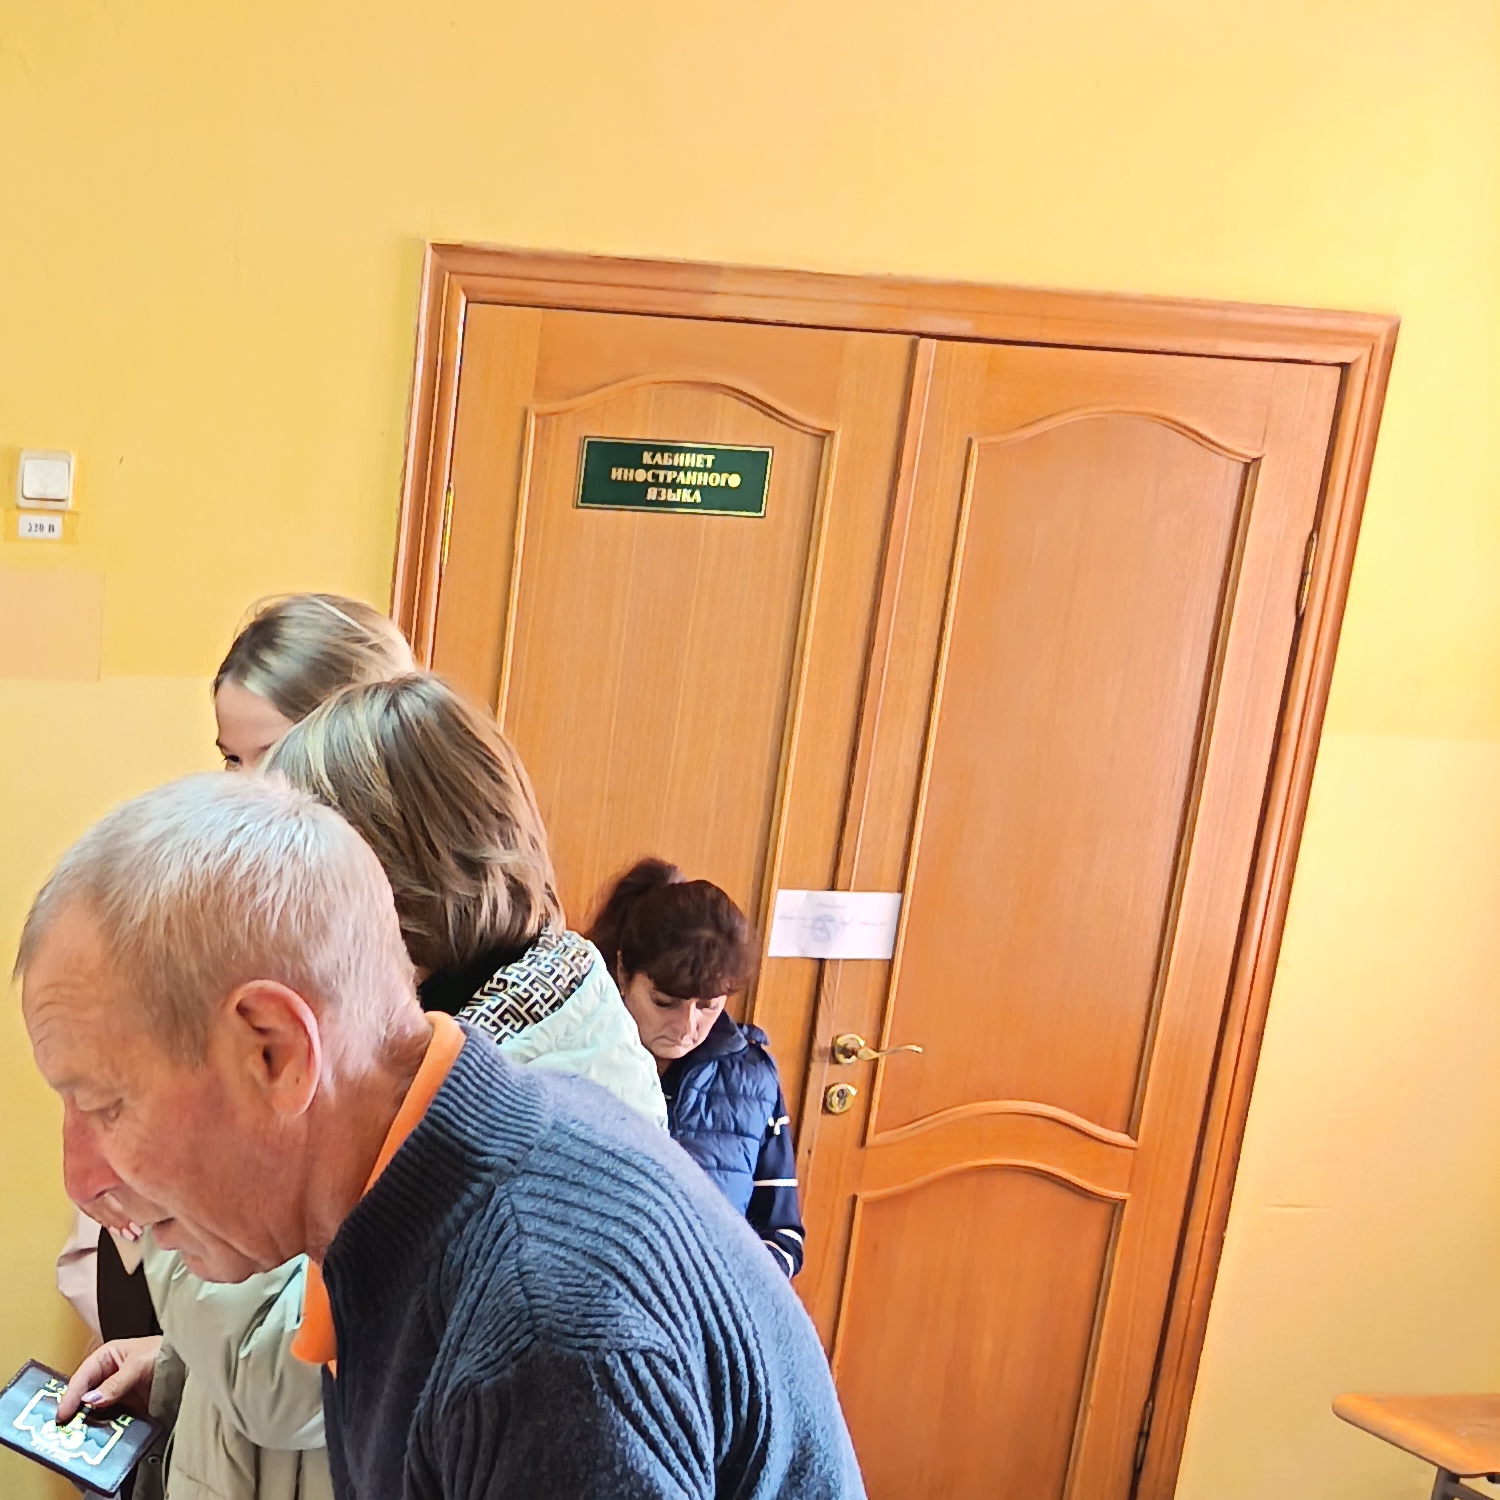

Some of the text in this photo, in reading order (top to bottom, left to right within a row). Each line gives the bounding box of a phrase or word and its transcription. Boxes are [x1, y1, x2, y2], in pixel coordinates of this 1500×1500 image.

[642, 451, 716, 468] КАБИНЕТ
[611, 467, 742, 488] ИНОСТРАННОГО
[646, 486, 702, 503] ЯЗЫКА
